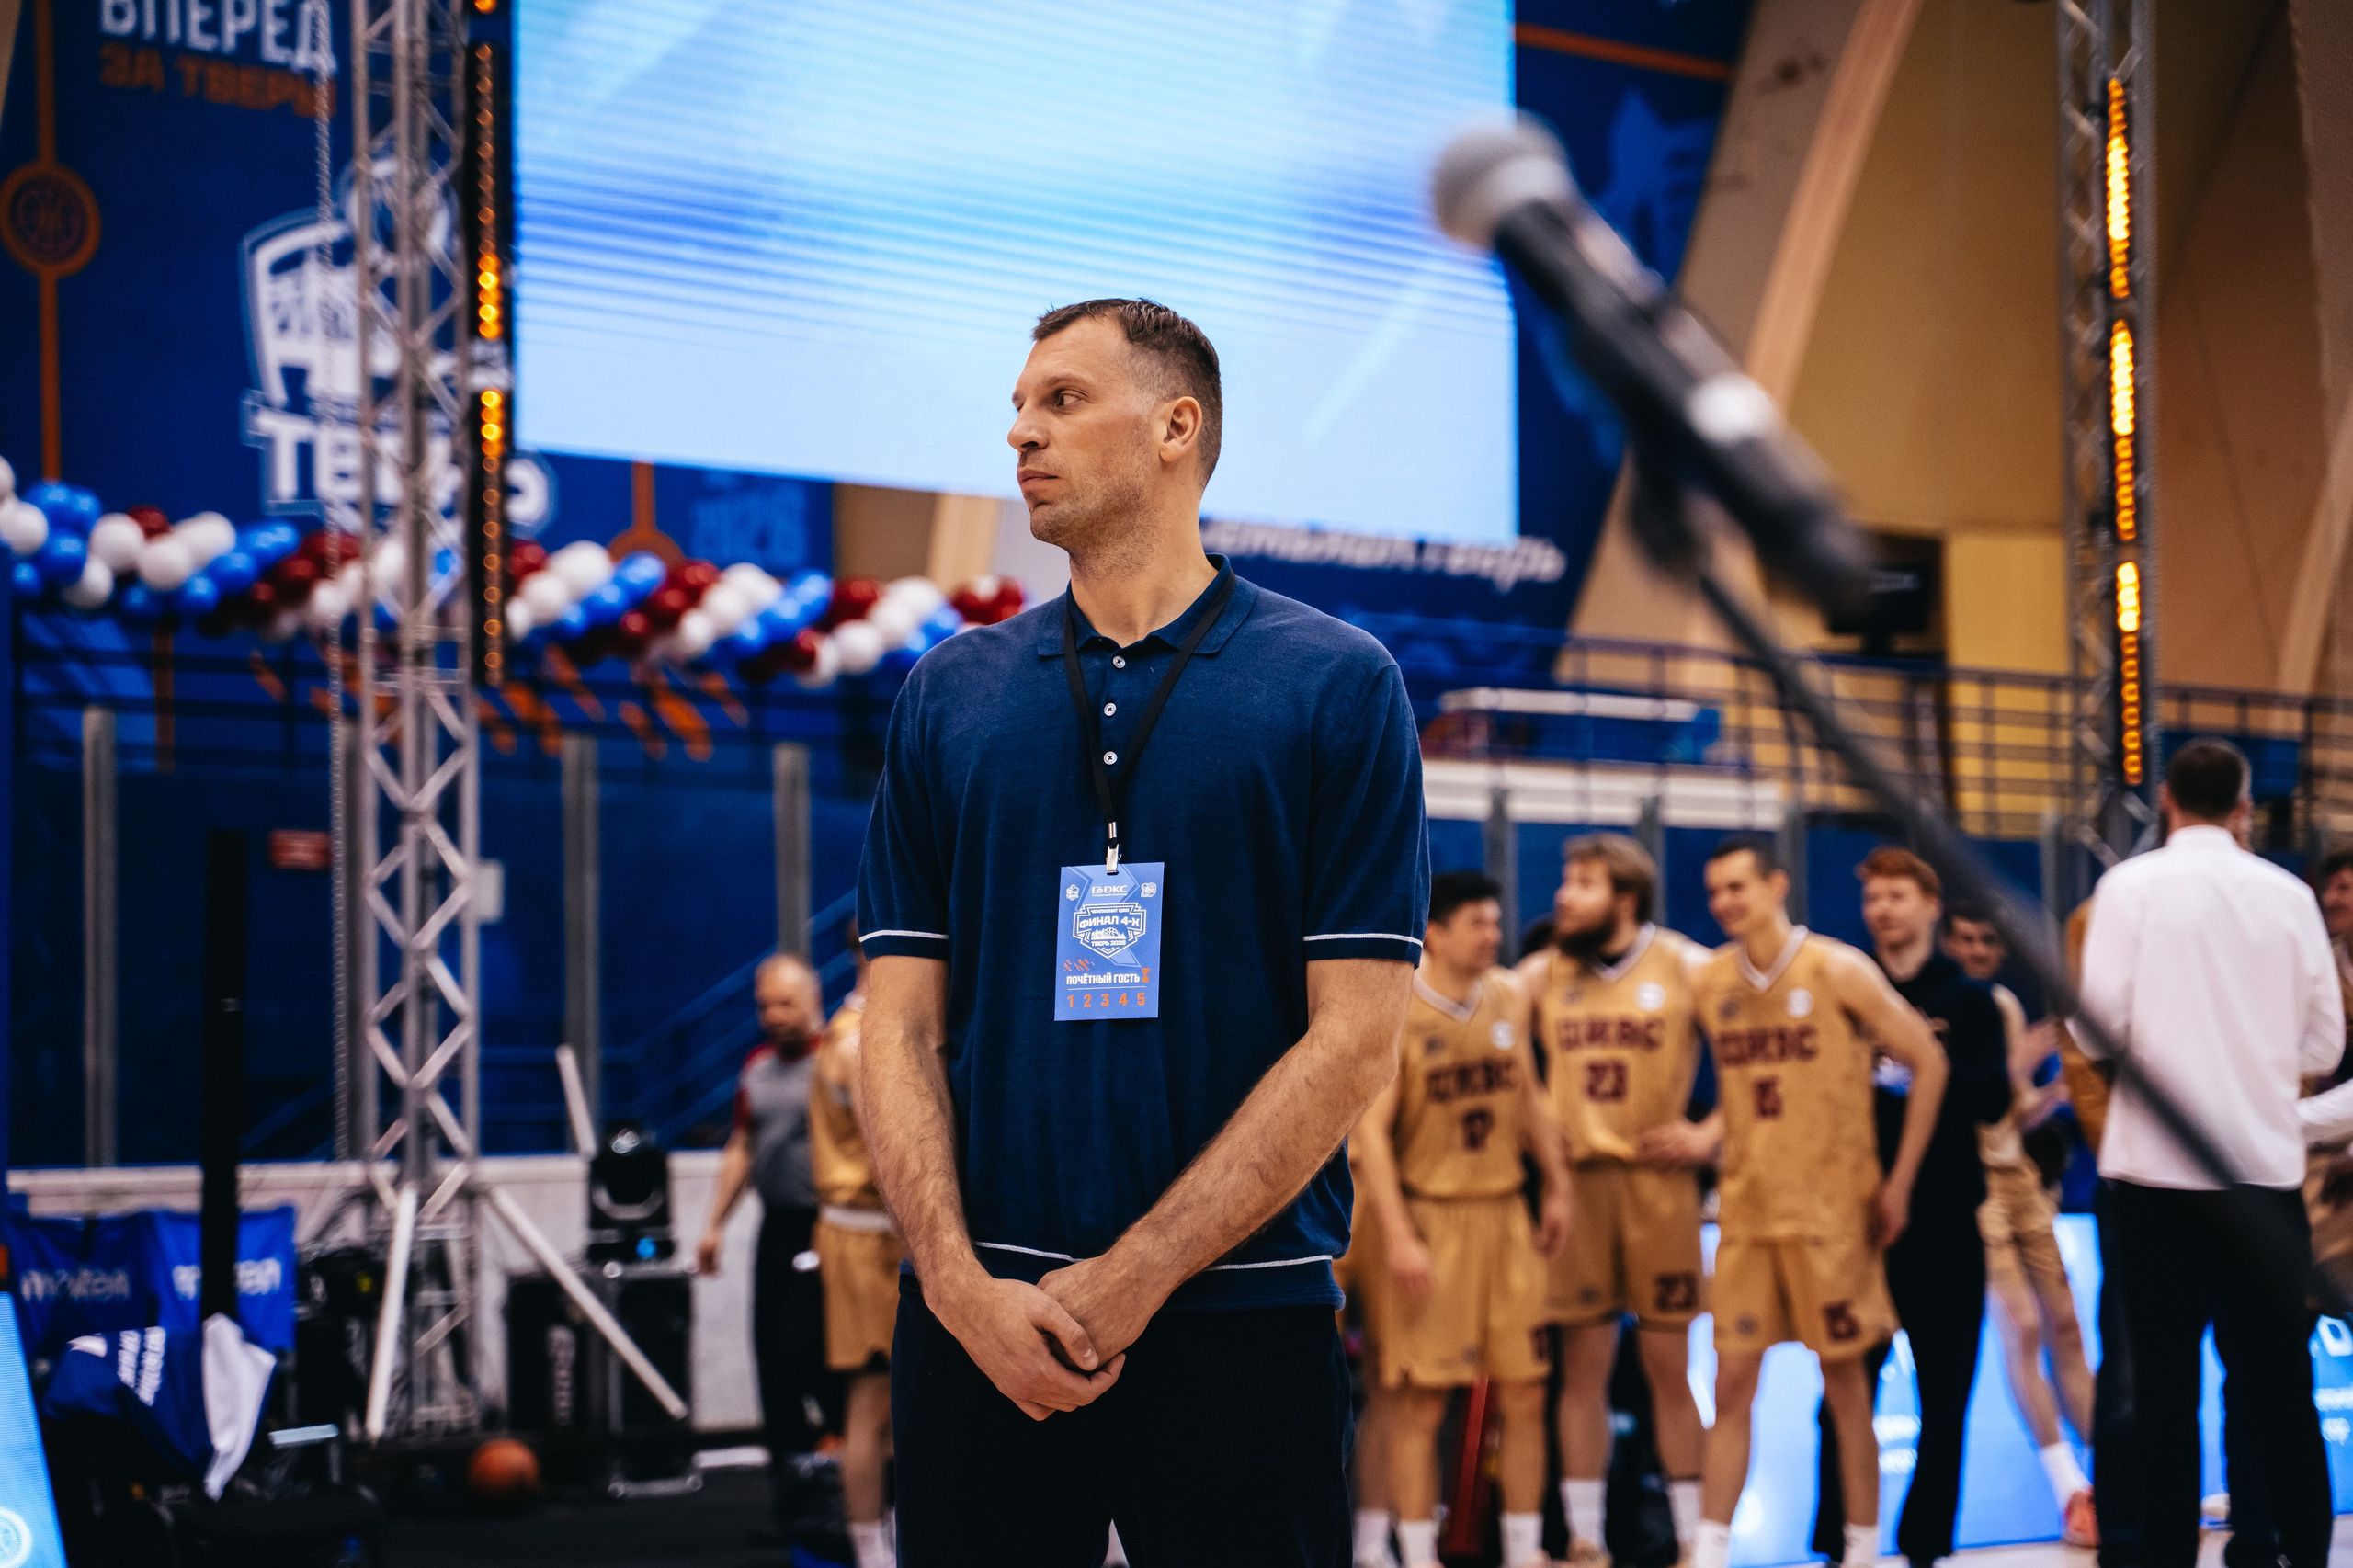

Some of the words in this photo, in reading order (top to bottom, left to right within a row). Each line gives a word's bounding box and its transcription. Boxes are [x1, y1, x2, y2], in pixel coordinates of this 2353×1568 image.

[1103, 884, 1129, 893] DKC
[1079, 915, 1120, 928] ФИНАЛ
[1066, 972, 1112, 985] ПОЧЁТНЫЙ
[1113, 973, 1141, 983] ГОСТЬ
[1067, 994, 1074, 1008] 1
[1084, 994, 1092, 1007] 2
[1100, 994, 1109, 1007] 3
[1119, 993, 1128, 1006] 4
[1137, 992, 1145, 1006] 5
[1585, 1059, 1628, 1103] 23
[1655, 1272, 1699, 1312] 23
